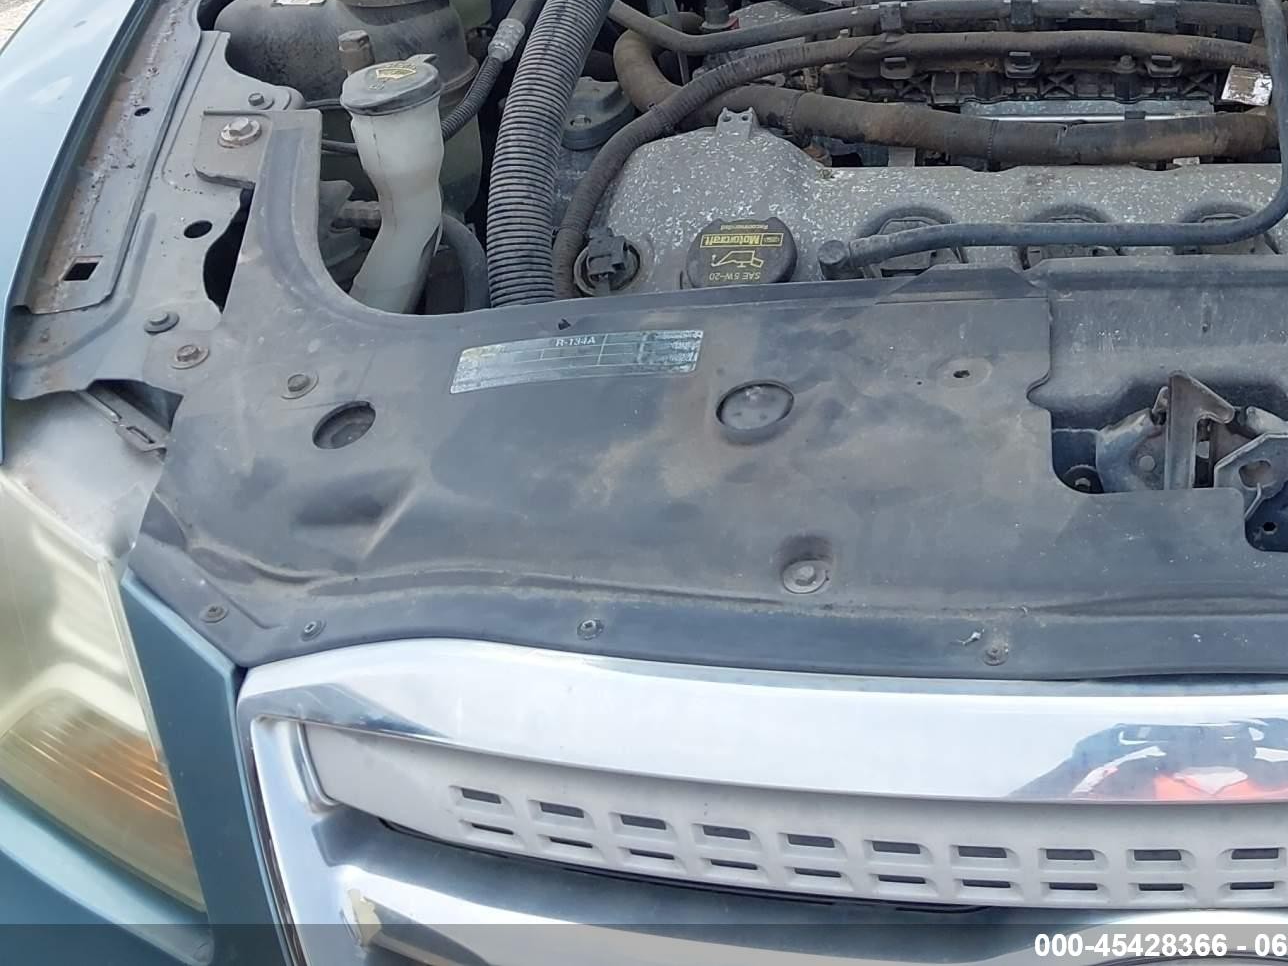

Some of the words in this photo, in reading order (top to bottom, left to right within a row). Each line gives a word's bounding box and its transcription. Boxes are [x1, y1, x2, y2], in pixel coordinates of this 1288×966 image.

[705, 235, 760, 246] Motorcraft
[741, 272, 761, 280] SAE
[555, 336, 596, 347] R-134A
